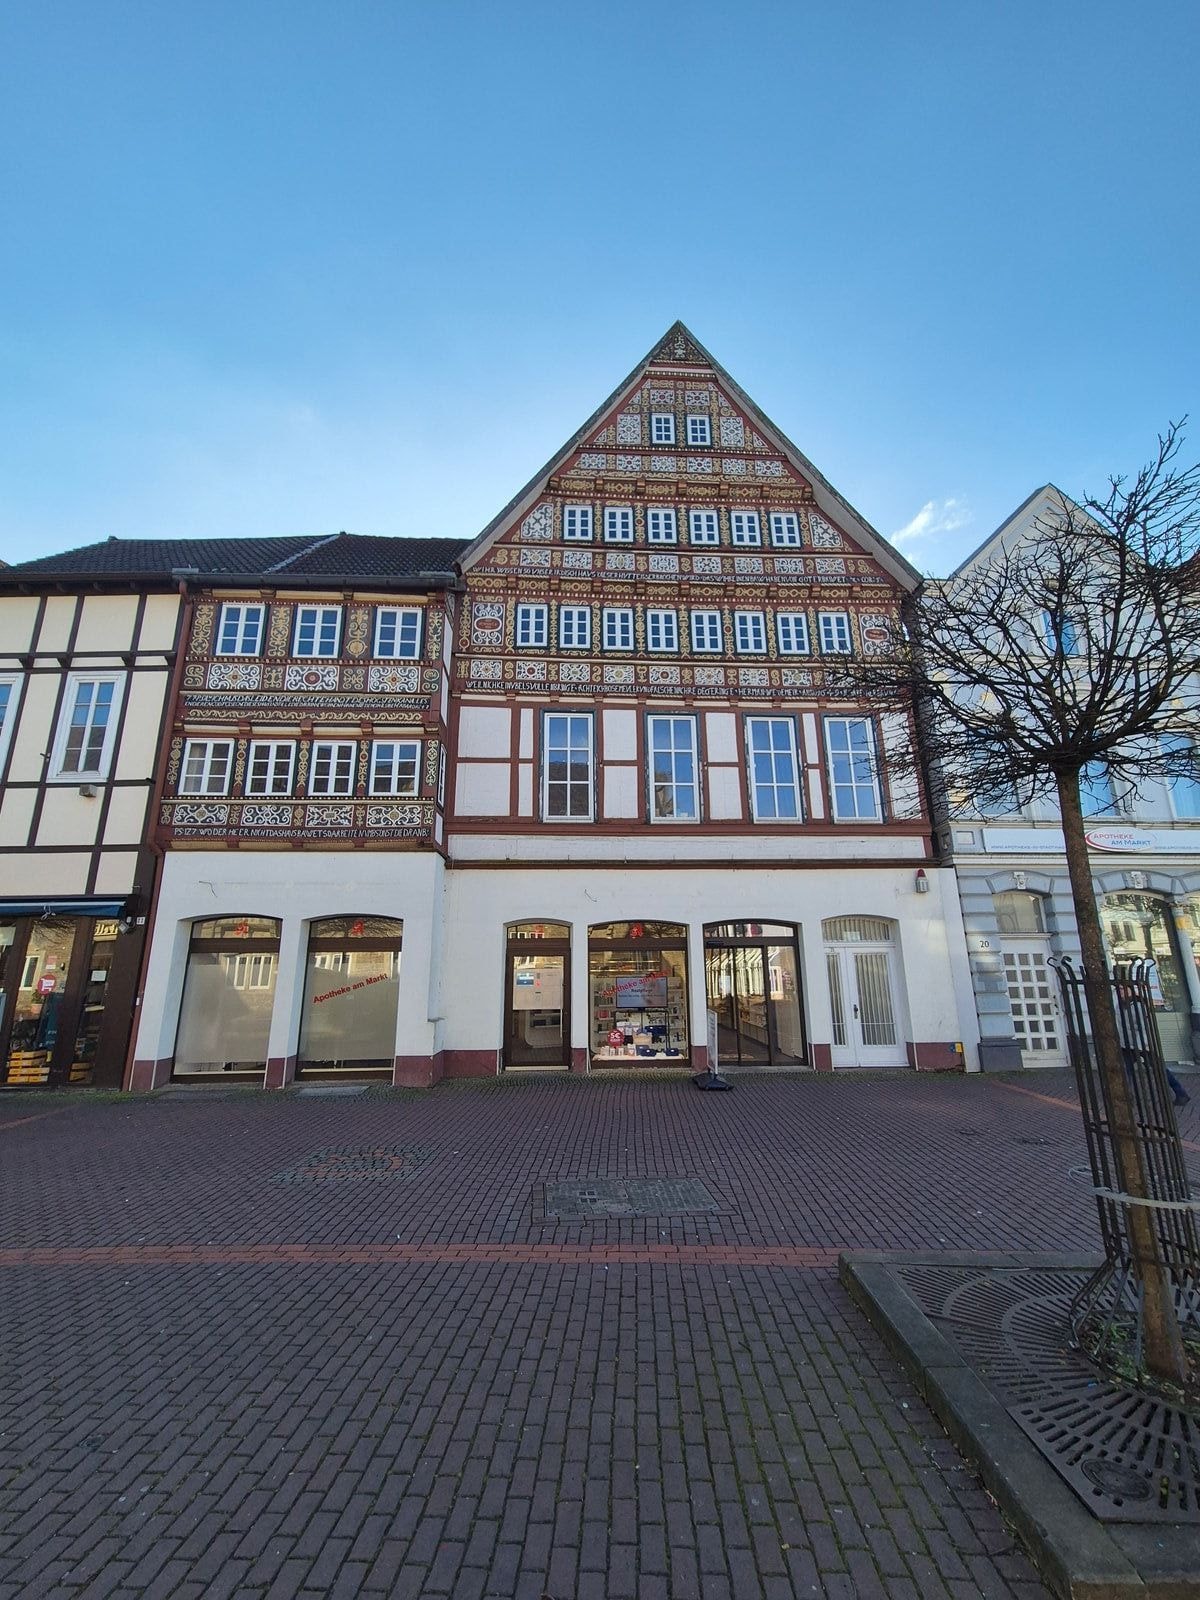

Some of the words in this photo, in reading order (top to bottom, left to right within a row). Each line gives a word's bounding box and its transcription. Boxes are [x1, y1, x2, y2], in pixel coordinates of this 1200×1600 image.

[313, 986, 351, 1004] Apotheke
[352, 981, 365, 990] am
[366, 973, 388, 985] Markt
